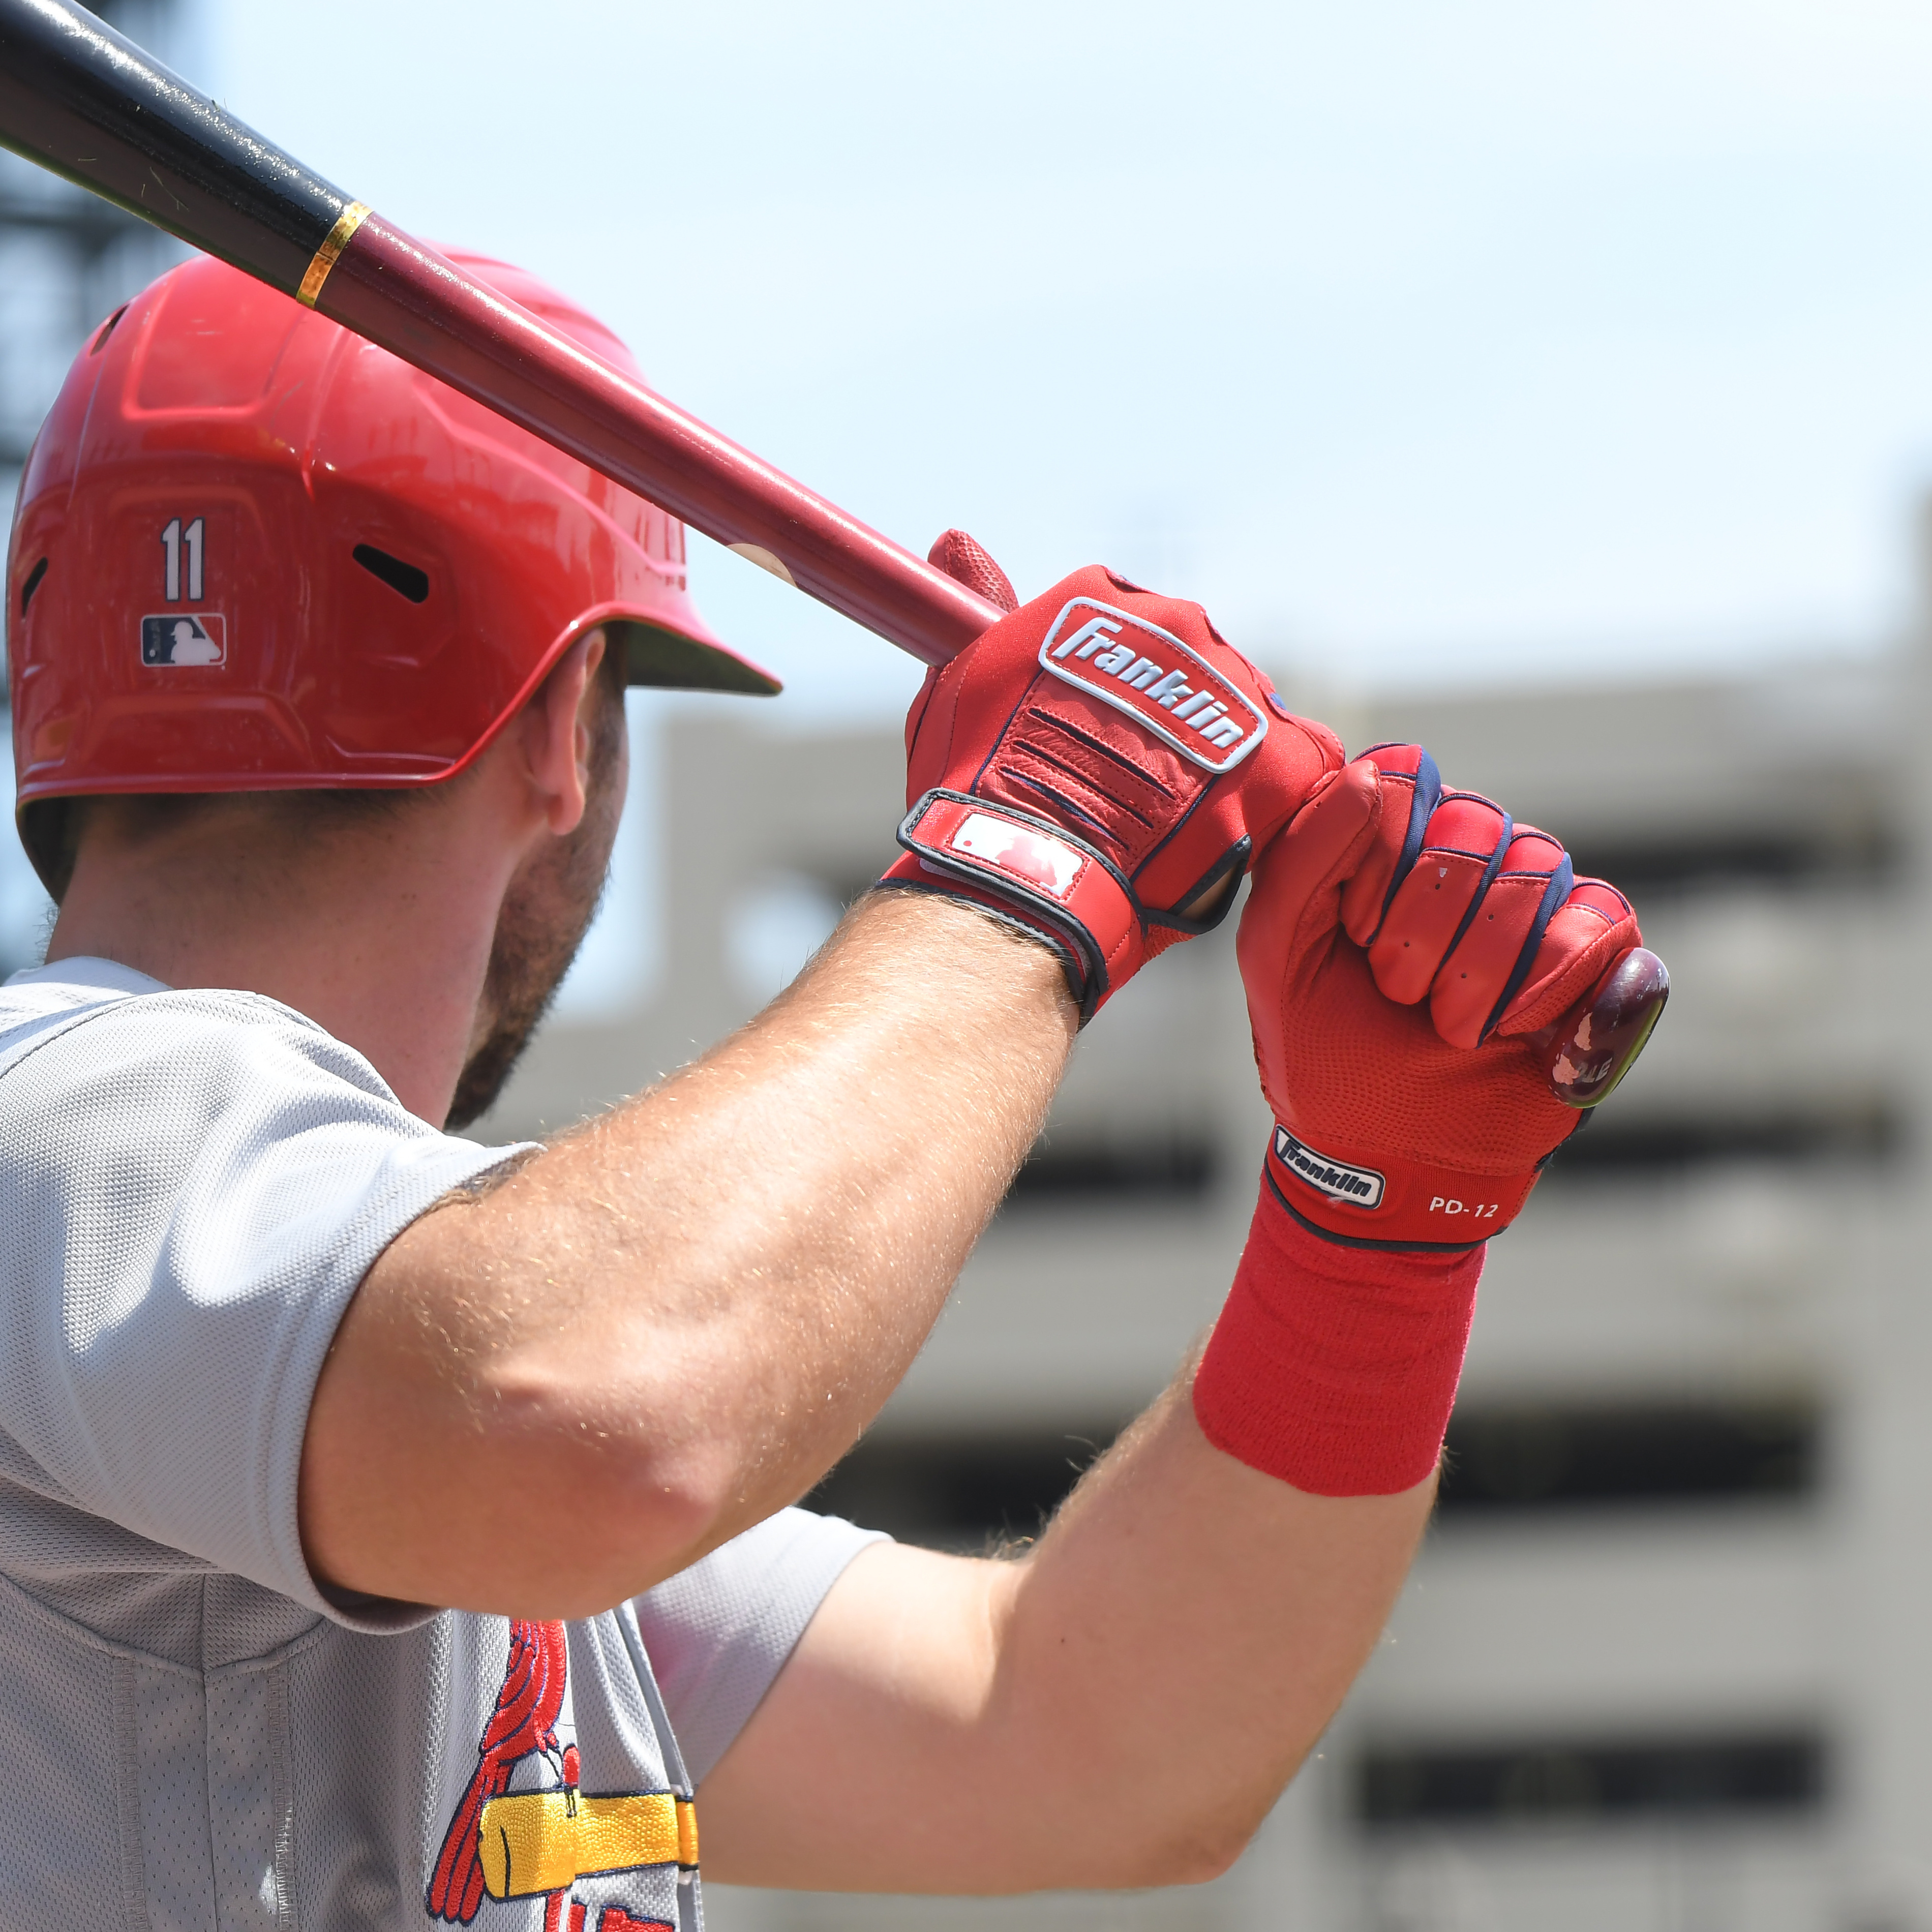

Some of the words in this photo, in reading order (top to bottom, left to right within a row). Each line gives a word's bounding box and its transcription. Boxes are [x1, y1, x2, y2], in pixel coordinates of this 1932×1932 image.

[161, 516, 205, 601] 11
[1051, 617, 1244, 749] Franklin
[1279, 1139, 1372, 1197] Franklin
[1429, 1196, 1498, 1217] PD-12
